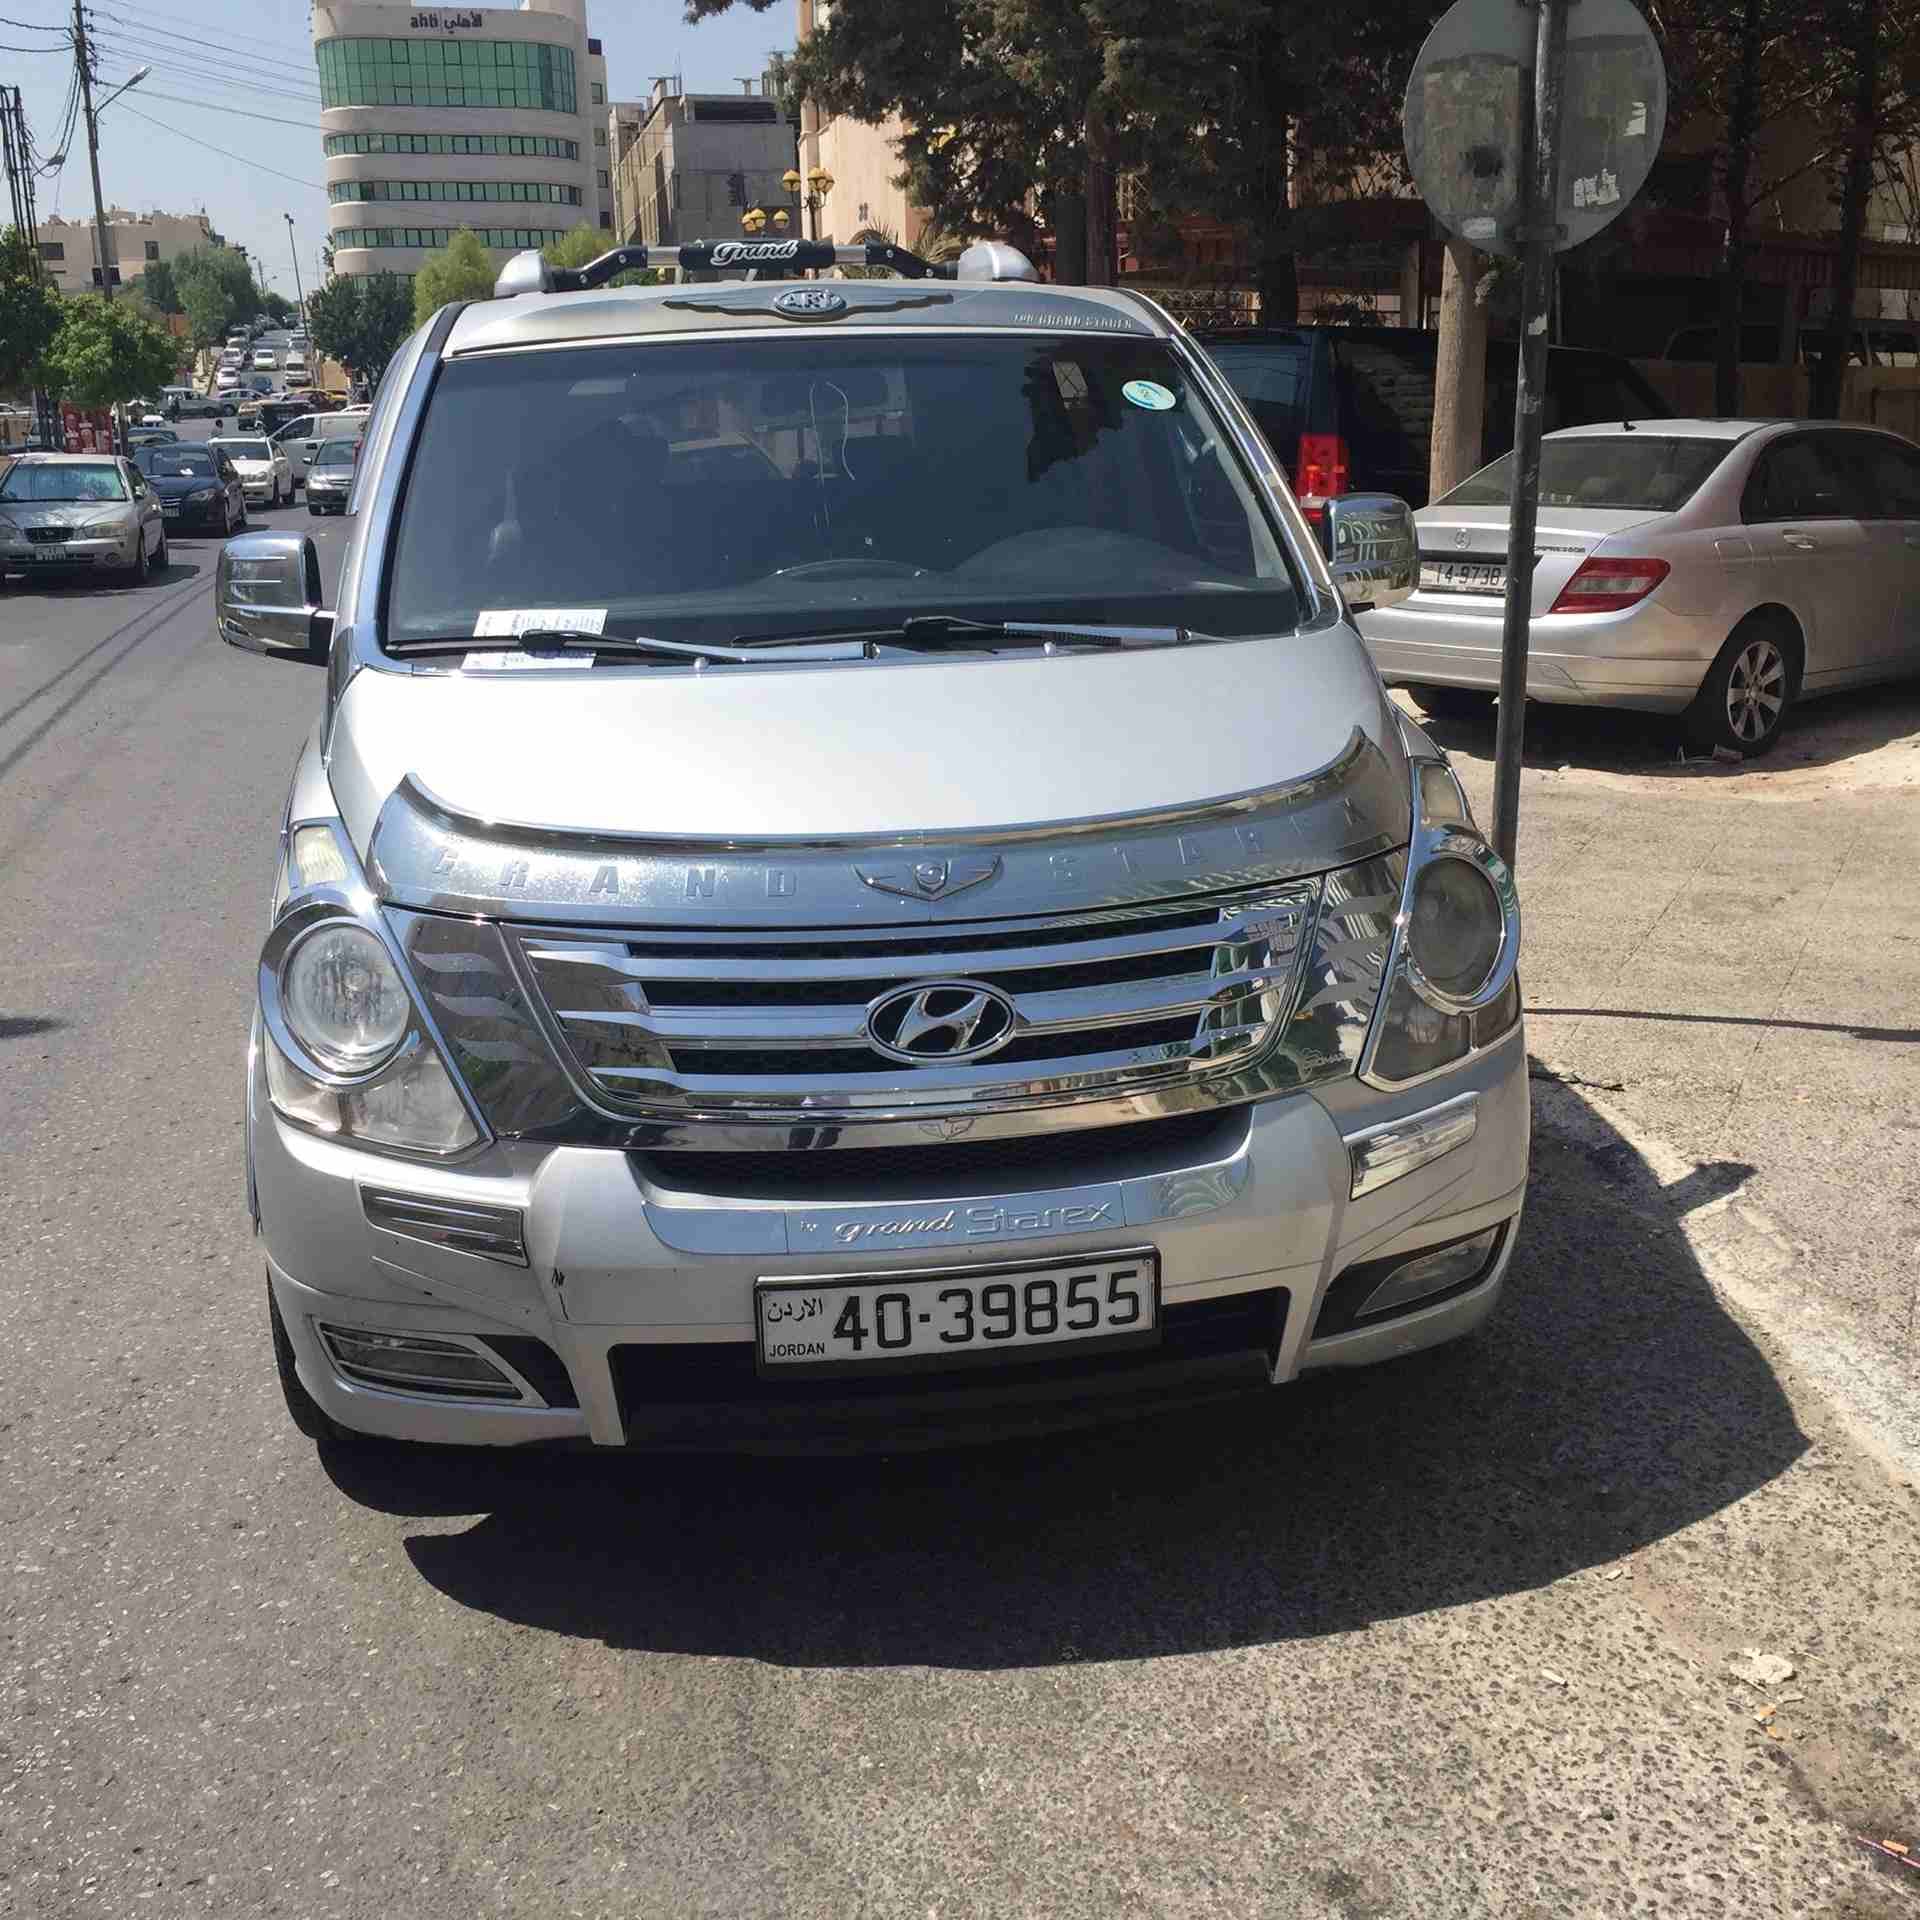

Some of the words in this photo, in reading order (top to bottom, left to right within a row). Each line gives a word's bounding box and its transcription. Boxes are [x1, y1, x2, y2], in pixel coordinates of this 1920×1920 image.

[710, 239, 799, 266] Grand
[834, 1209, 956, 1244] grand
[965, 1200, 1113, 1234] Starex
[832, 1270, 1142, 1351] 40-39855
[768, 1342, 826, 1358] JORDAN
